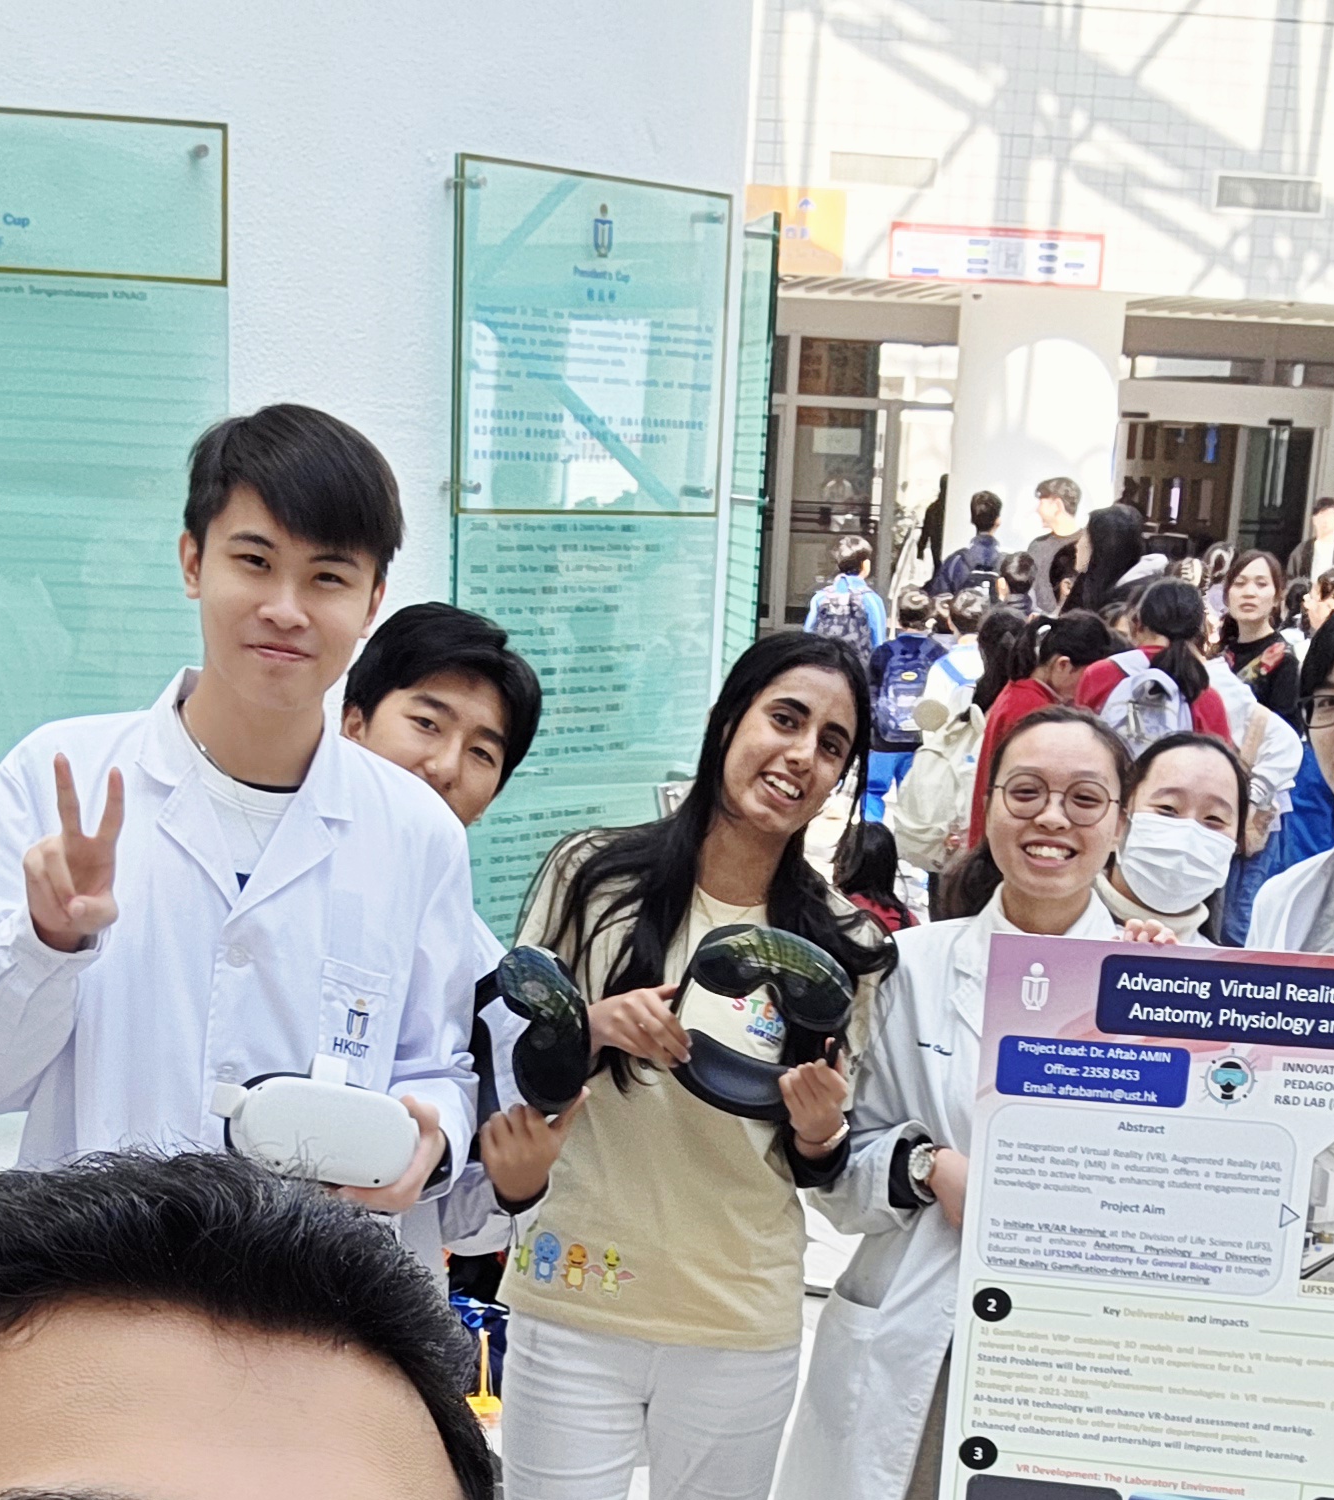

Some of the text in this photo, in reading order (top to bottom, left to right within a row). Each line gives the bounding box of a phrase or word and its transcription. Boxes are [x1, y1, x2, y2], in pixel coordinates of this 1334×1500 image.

[2, 213, 30, 228] Cup
[1116, 972, 1210, 999] Advancing
[1220, 979, 1280, 1000] Virtual
[732, 998, 783, 1023] STE
[1128, 1002, 1212, 1028] Anatomy,
[1218, 1008, 1314, 1035] Physiology
[333, 1037, 369, 1059] HKUST
[1017, 1040, 1171, 1062] Project Lead: Dr. Aftab AMIN
[1044, 1063, 1139, 1080] Office: 2358 8453
[1023, 1081, 1156, 1102] Email: aftabamin@ust.hk
[1273, 1094, 1300, 1105] R&D
[1303, 1096, 1325, 1107] LAB
[1117, 1121, 1164, 1134] Abstract
[1100, 1200, 1165, 1215] Project Aim
[987, 1299, 997, 1312] 2
[1102, 1305, 1121, 1317] Key
[1186, 1314, 1207, 1324] and
[973, 1447, 983, 1460] 3
[1016, 1463, 1245, 1496] VR Development: The Laboratory Environment
